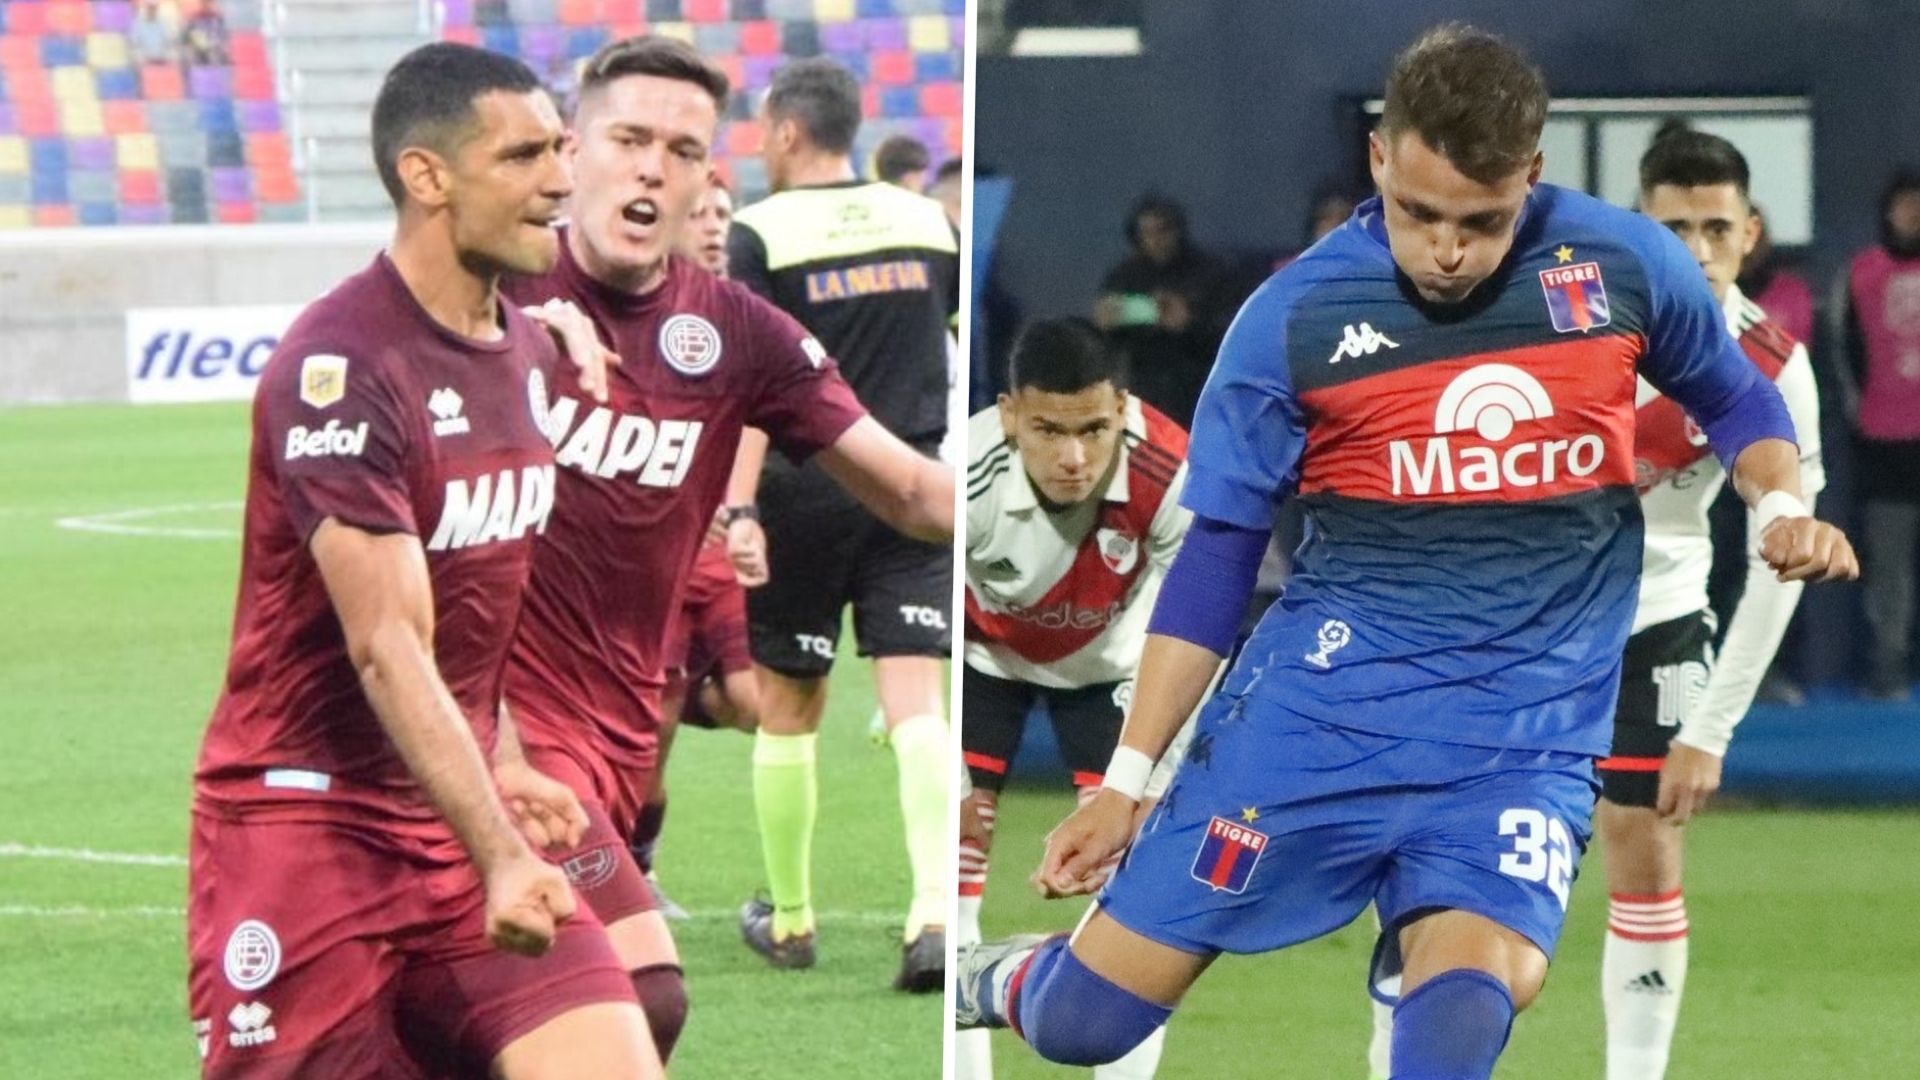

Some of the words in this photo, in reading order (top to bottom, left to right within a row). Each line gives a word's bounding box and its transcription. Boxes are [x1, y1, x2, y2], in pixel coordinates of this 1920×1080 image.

[807, 271, 845, 302] LA
[1544, 266, 1596, 287] TIGRE
[285, 419, 368, 459] Befol
[1389, 434, 1605, 496] Macro
[900, 605, 948, 629] TCL
[796, 633, 835, 659] TCL
[1214, 820, 1263, 850] TIGRE
[1498, 808, 1573, 913] 32
